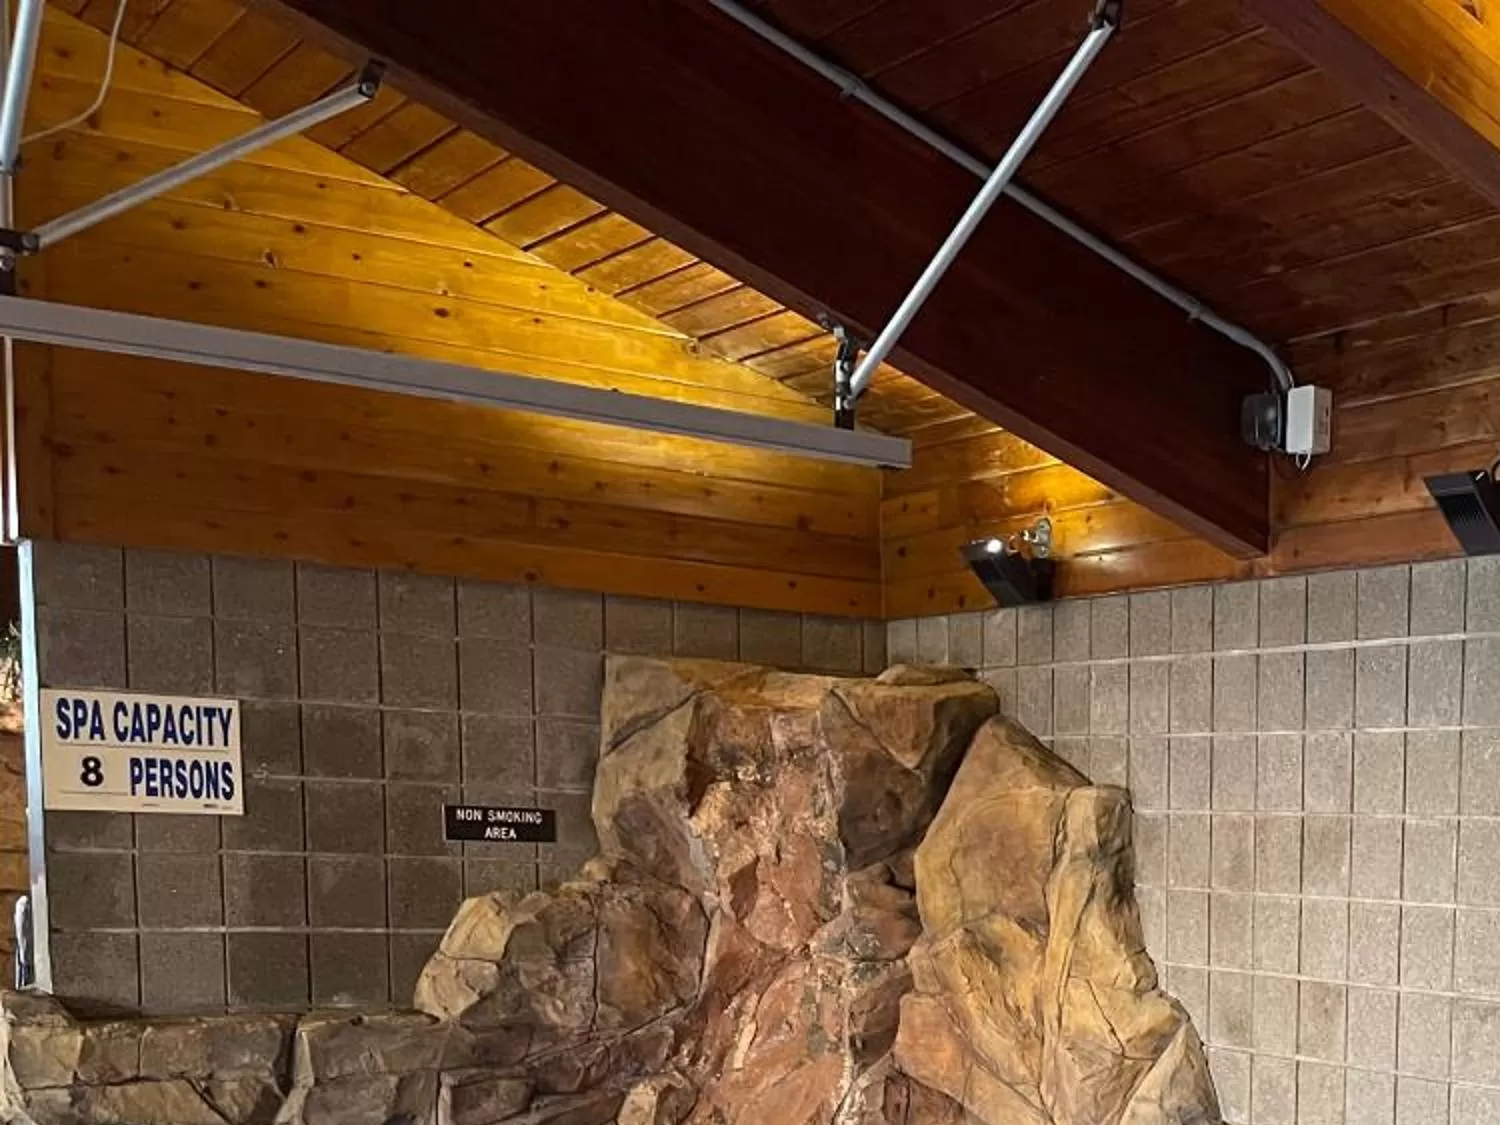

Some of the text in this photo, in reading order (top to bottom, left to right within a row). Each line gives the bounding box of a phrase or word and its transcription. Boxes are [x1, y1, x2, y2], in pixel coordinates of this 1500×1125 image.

[56, 698, 232, 747] SPA CAPACITY
[80, 756, 235, 801] 8 PERSONS
[456, 808, 543, 824] NON SMOKING
[484, 827, 517, 839] AREA
